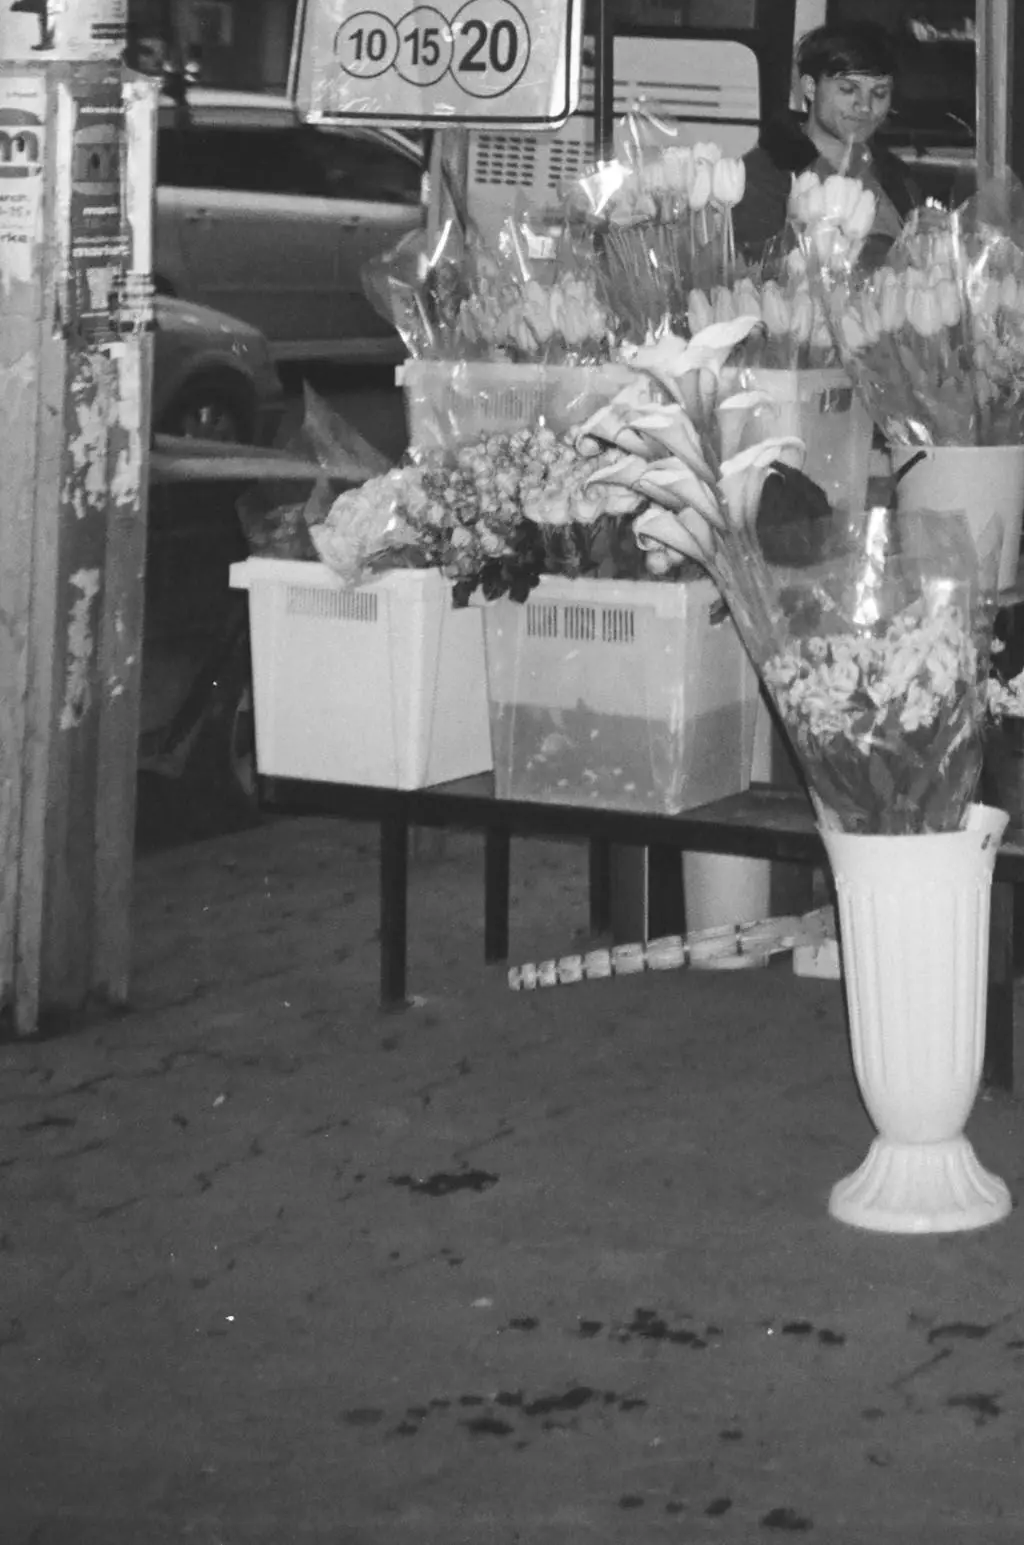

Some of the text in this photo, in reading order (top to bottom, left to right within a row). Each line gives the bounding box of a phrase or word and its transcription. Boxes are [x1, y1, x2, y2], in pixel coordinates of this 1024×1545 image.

[349, 19, 518, 73] 10 15 20
